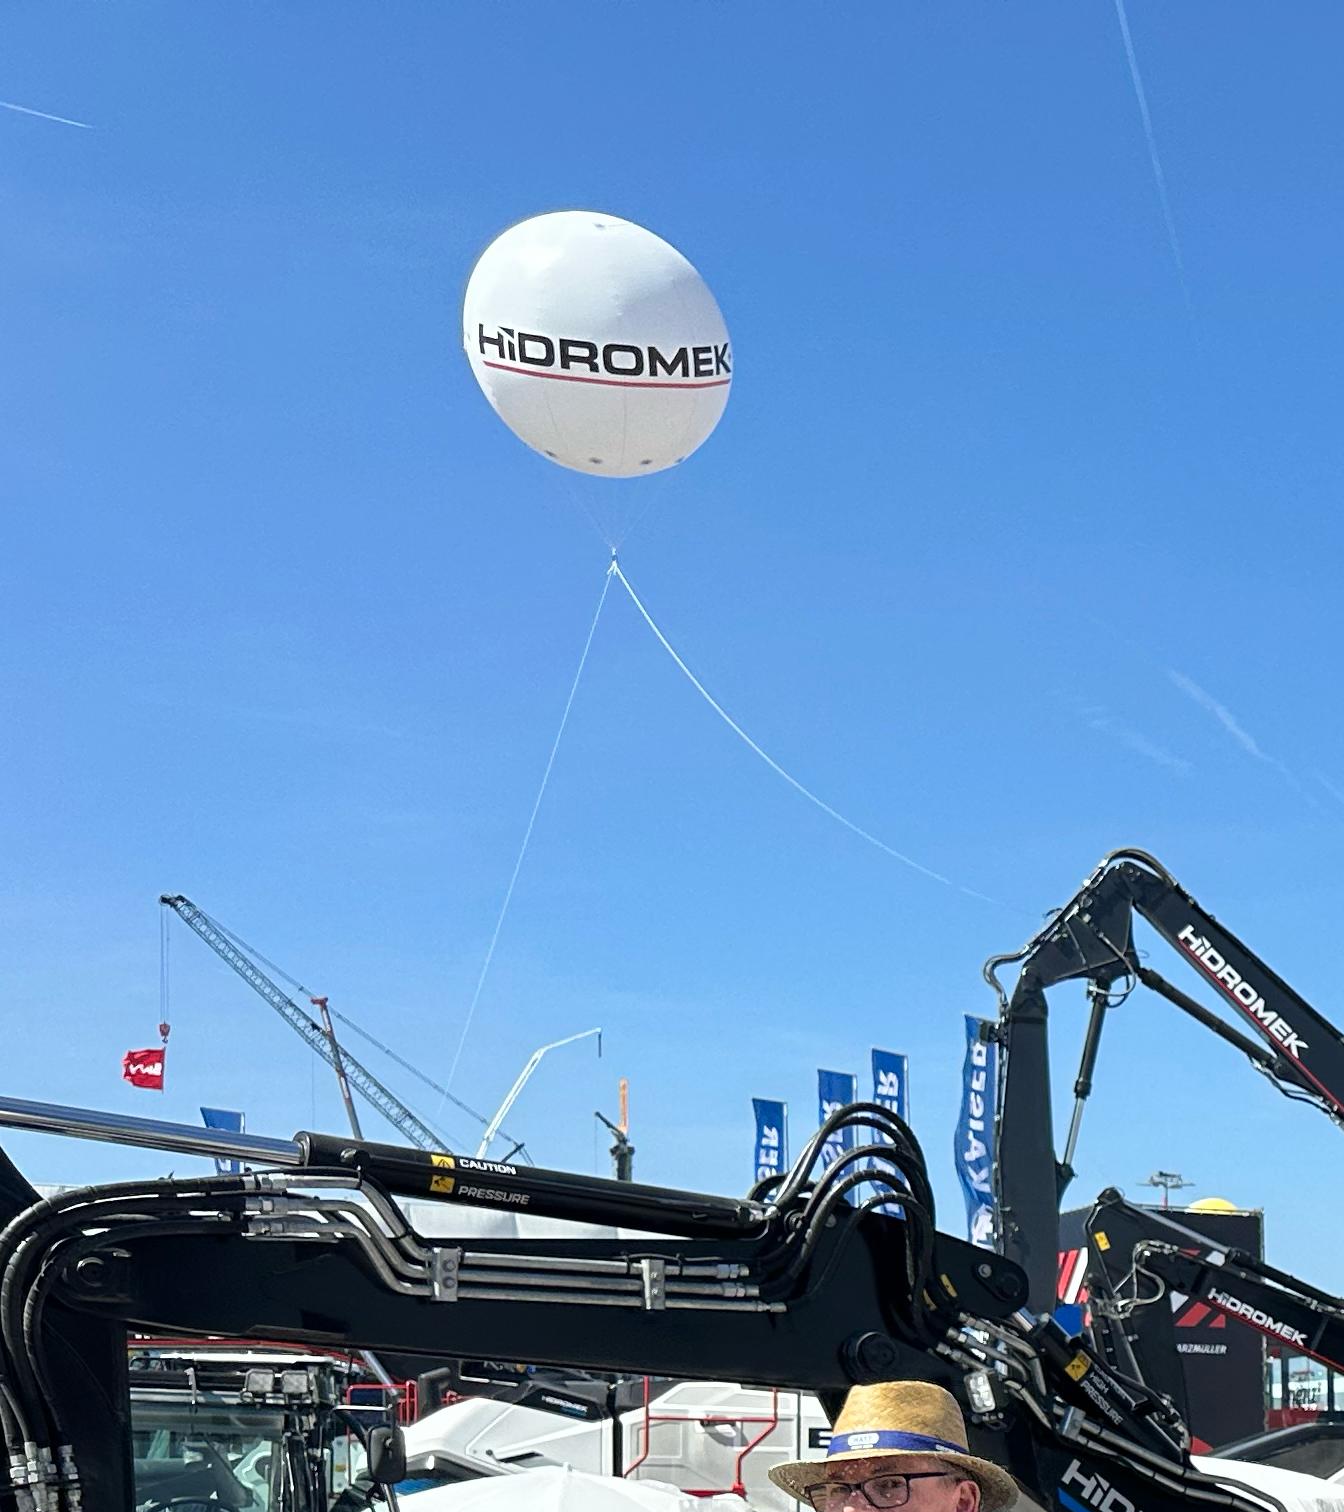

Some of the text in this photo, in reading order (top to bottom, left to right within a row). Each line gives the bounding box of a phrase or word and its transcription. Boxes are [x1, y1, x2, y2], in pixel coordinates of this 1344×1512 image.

[460, 1159, 516, 1175] CAUTION
[458, 1185, 530, 1205] PRESSURE
[1080, 1380, 1124, 1425] PRESSURE
